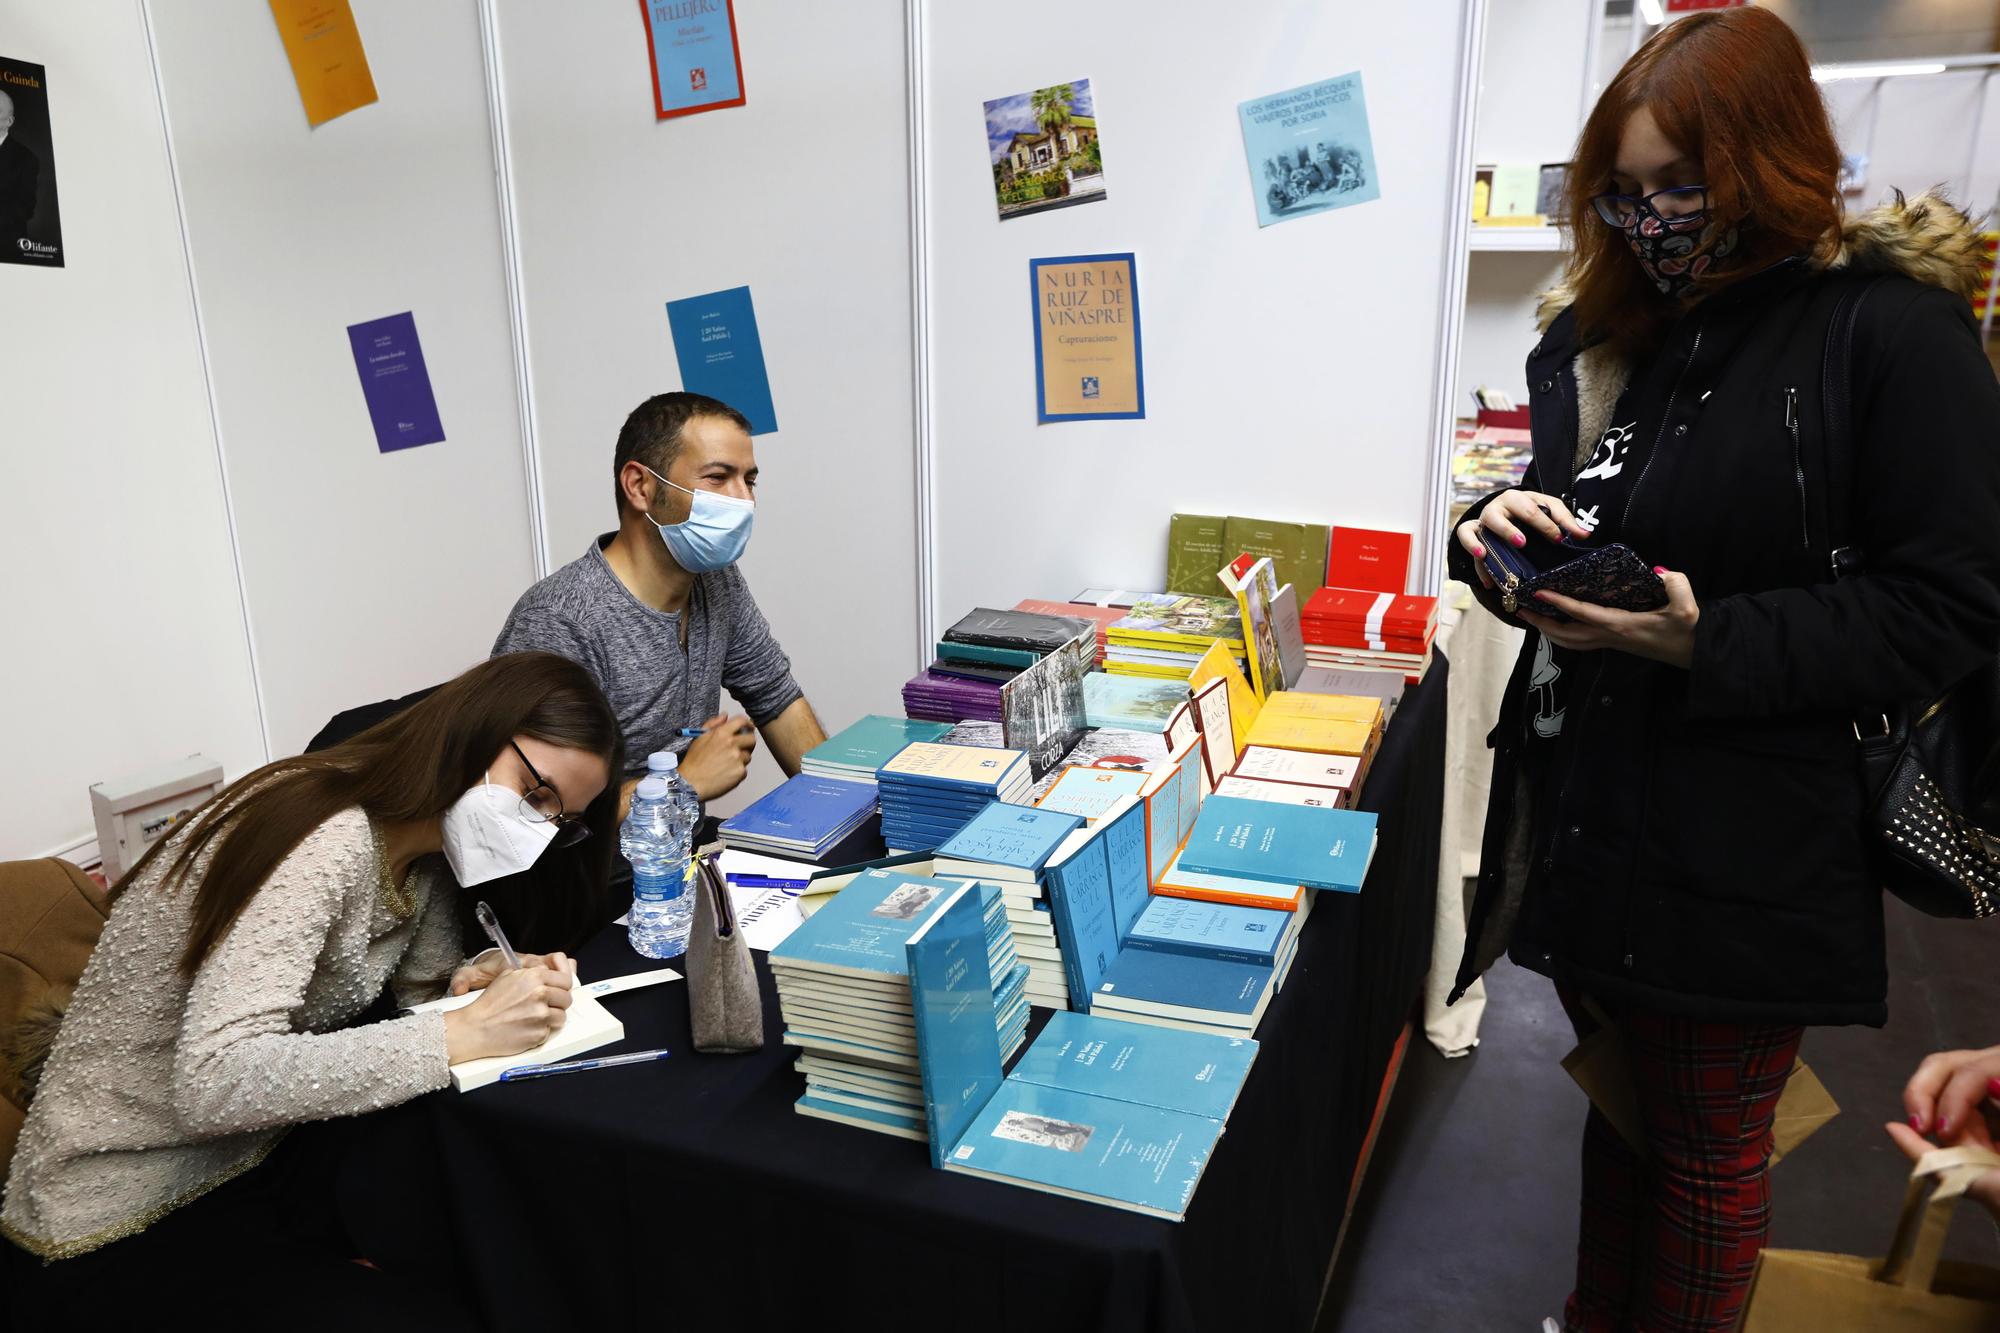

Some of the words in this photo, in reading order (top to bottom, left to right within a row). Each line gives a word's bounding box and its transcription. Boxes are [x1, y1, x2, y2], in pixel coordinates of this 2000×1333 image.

[4, 71, 39, 88] Guinda
[1246, 104, 1263, 116] LOS
[1265, 91, 1312, 110] HERMANOS
[1254, 108, 1292, 124] VIAJEROS
[1281, 118, 1299, 128] POR
[1301, 110, 1327, 123] SORIA
[17, 238, 58, 254] Olifante
[1046, 270, 1124, 288] NURIA
[1047, 291, 1089, 308] RUIZ
[1102, 289, 1125, 305] DE
[1049, 307, 1127, 326] VIÑASPRE
[1058, 334, 1118, 346] Capturaciones
[1041, 741, 1064, 771] CORZA
[1110, 816, 1142, 848] CELIA
[1112, 829, 1143, 865] CARRASCO
[1067, 848, 1103, 887] CELIA
[1120, 852, 1137, 874] GIL
[1071, 864, 1103, 904] CARRASCO
[739, 886, 800, 928] lifante
[1081, 888, 1100, 914] GIL
[1181, 912, 1202, 930] GIL
